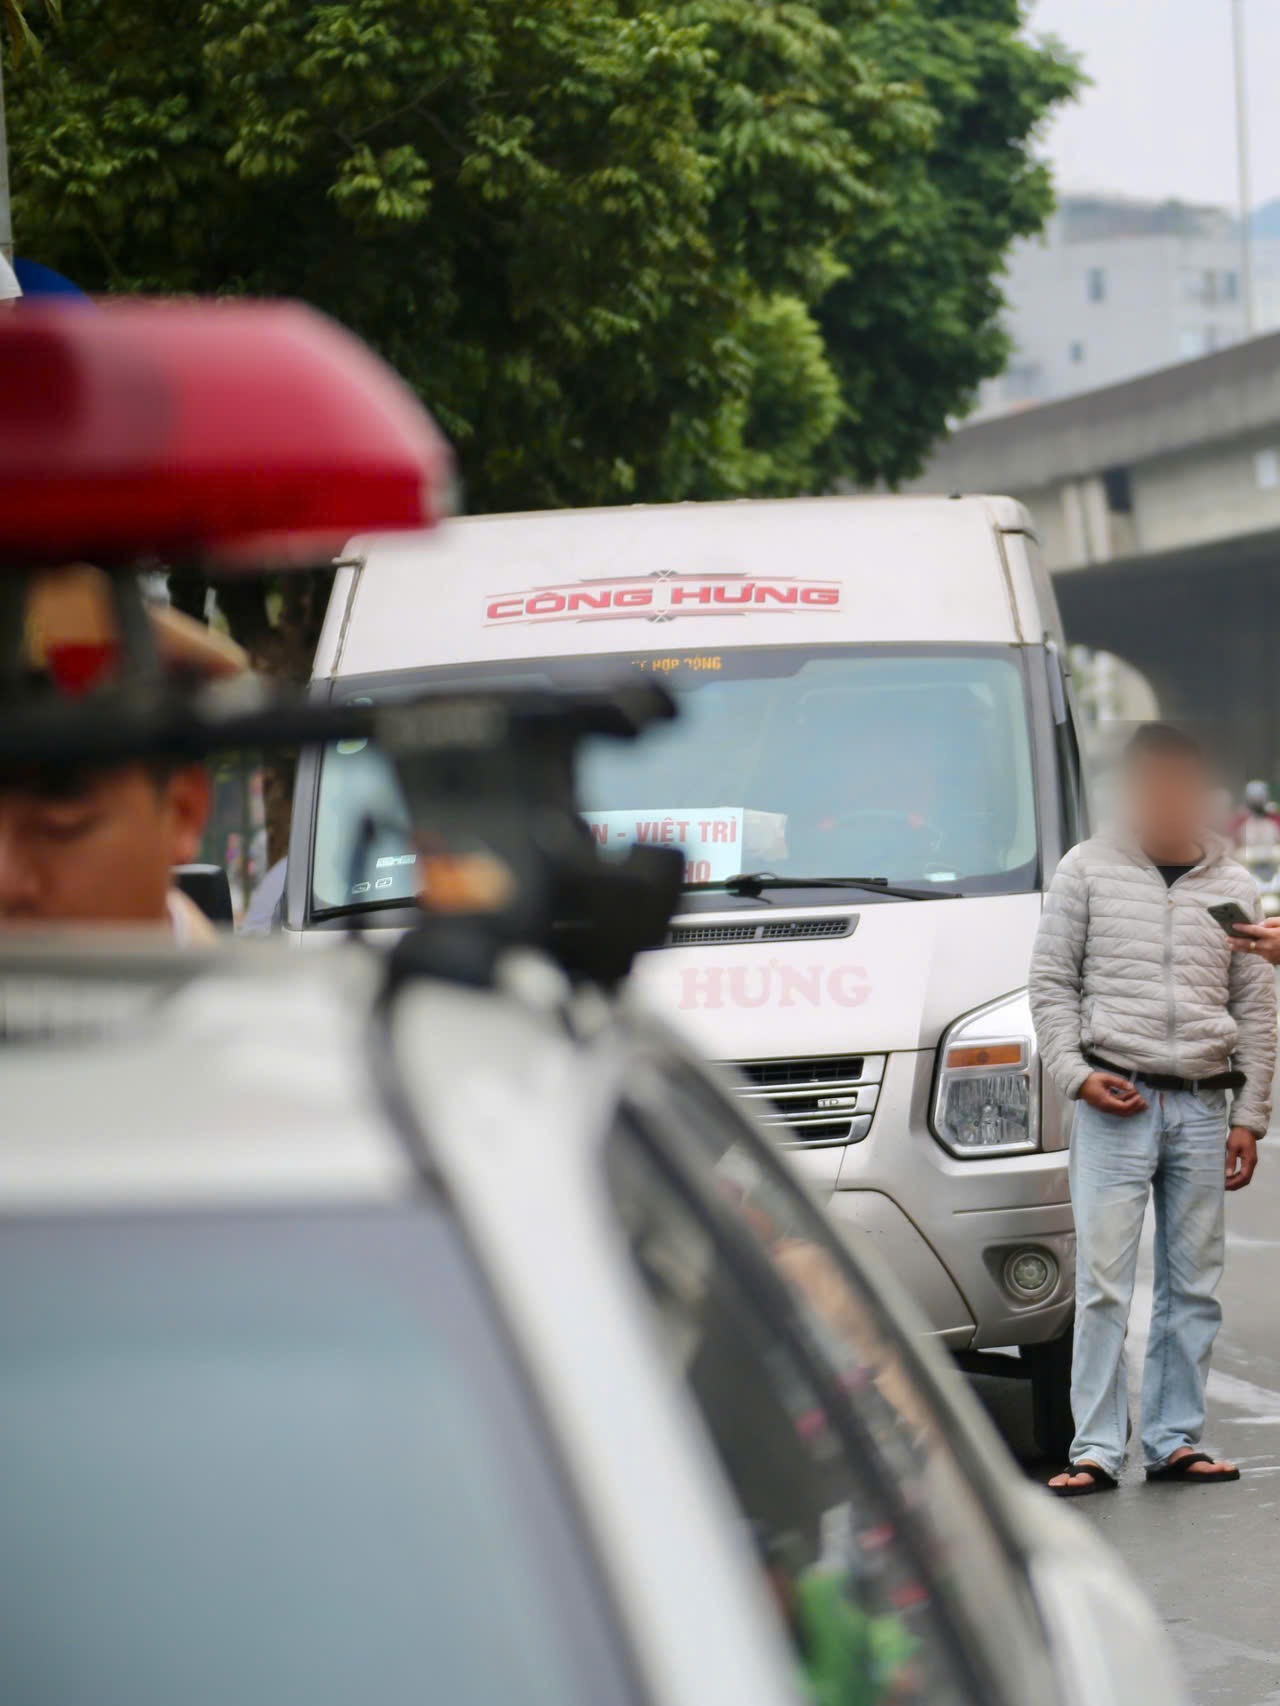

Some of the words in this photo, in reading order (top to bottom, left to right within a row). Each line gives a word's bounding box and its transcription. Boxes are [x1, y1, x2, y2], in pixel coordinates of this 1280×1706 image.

[487, 589, 653, 620] CÔNG
[671, 583, 840, 605] HƯNG
[635, 816, 691, 848] VIỆT
[697, 815, 738, 844] TRÌ
[678, 957, 874, 1010] HƯNG
